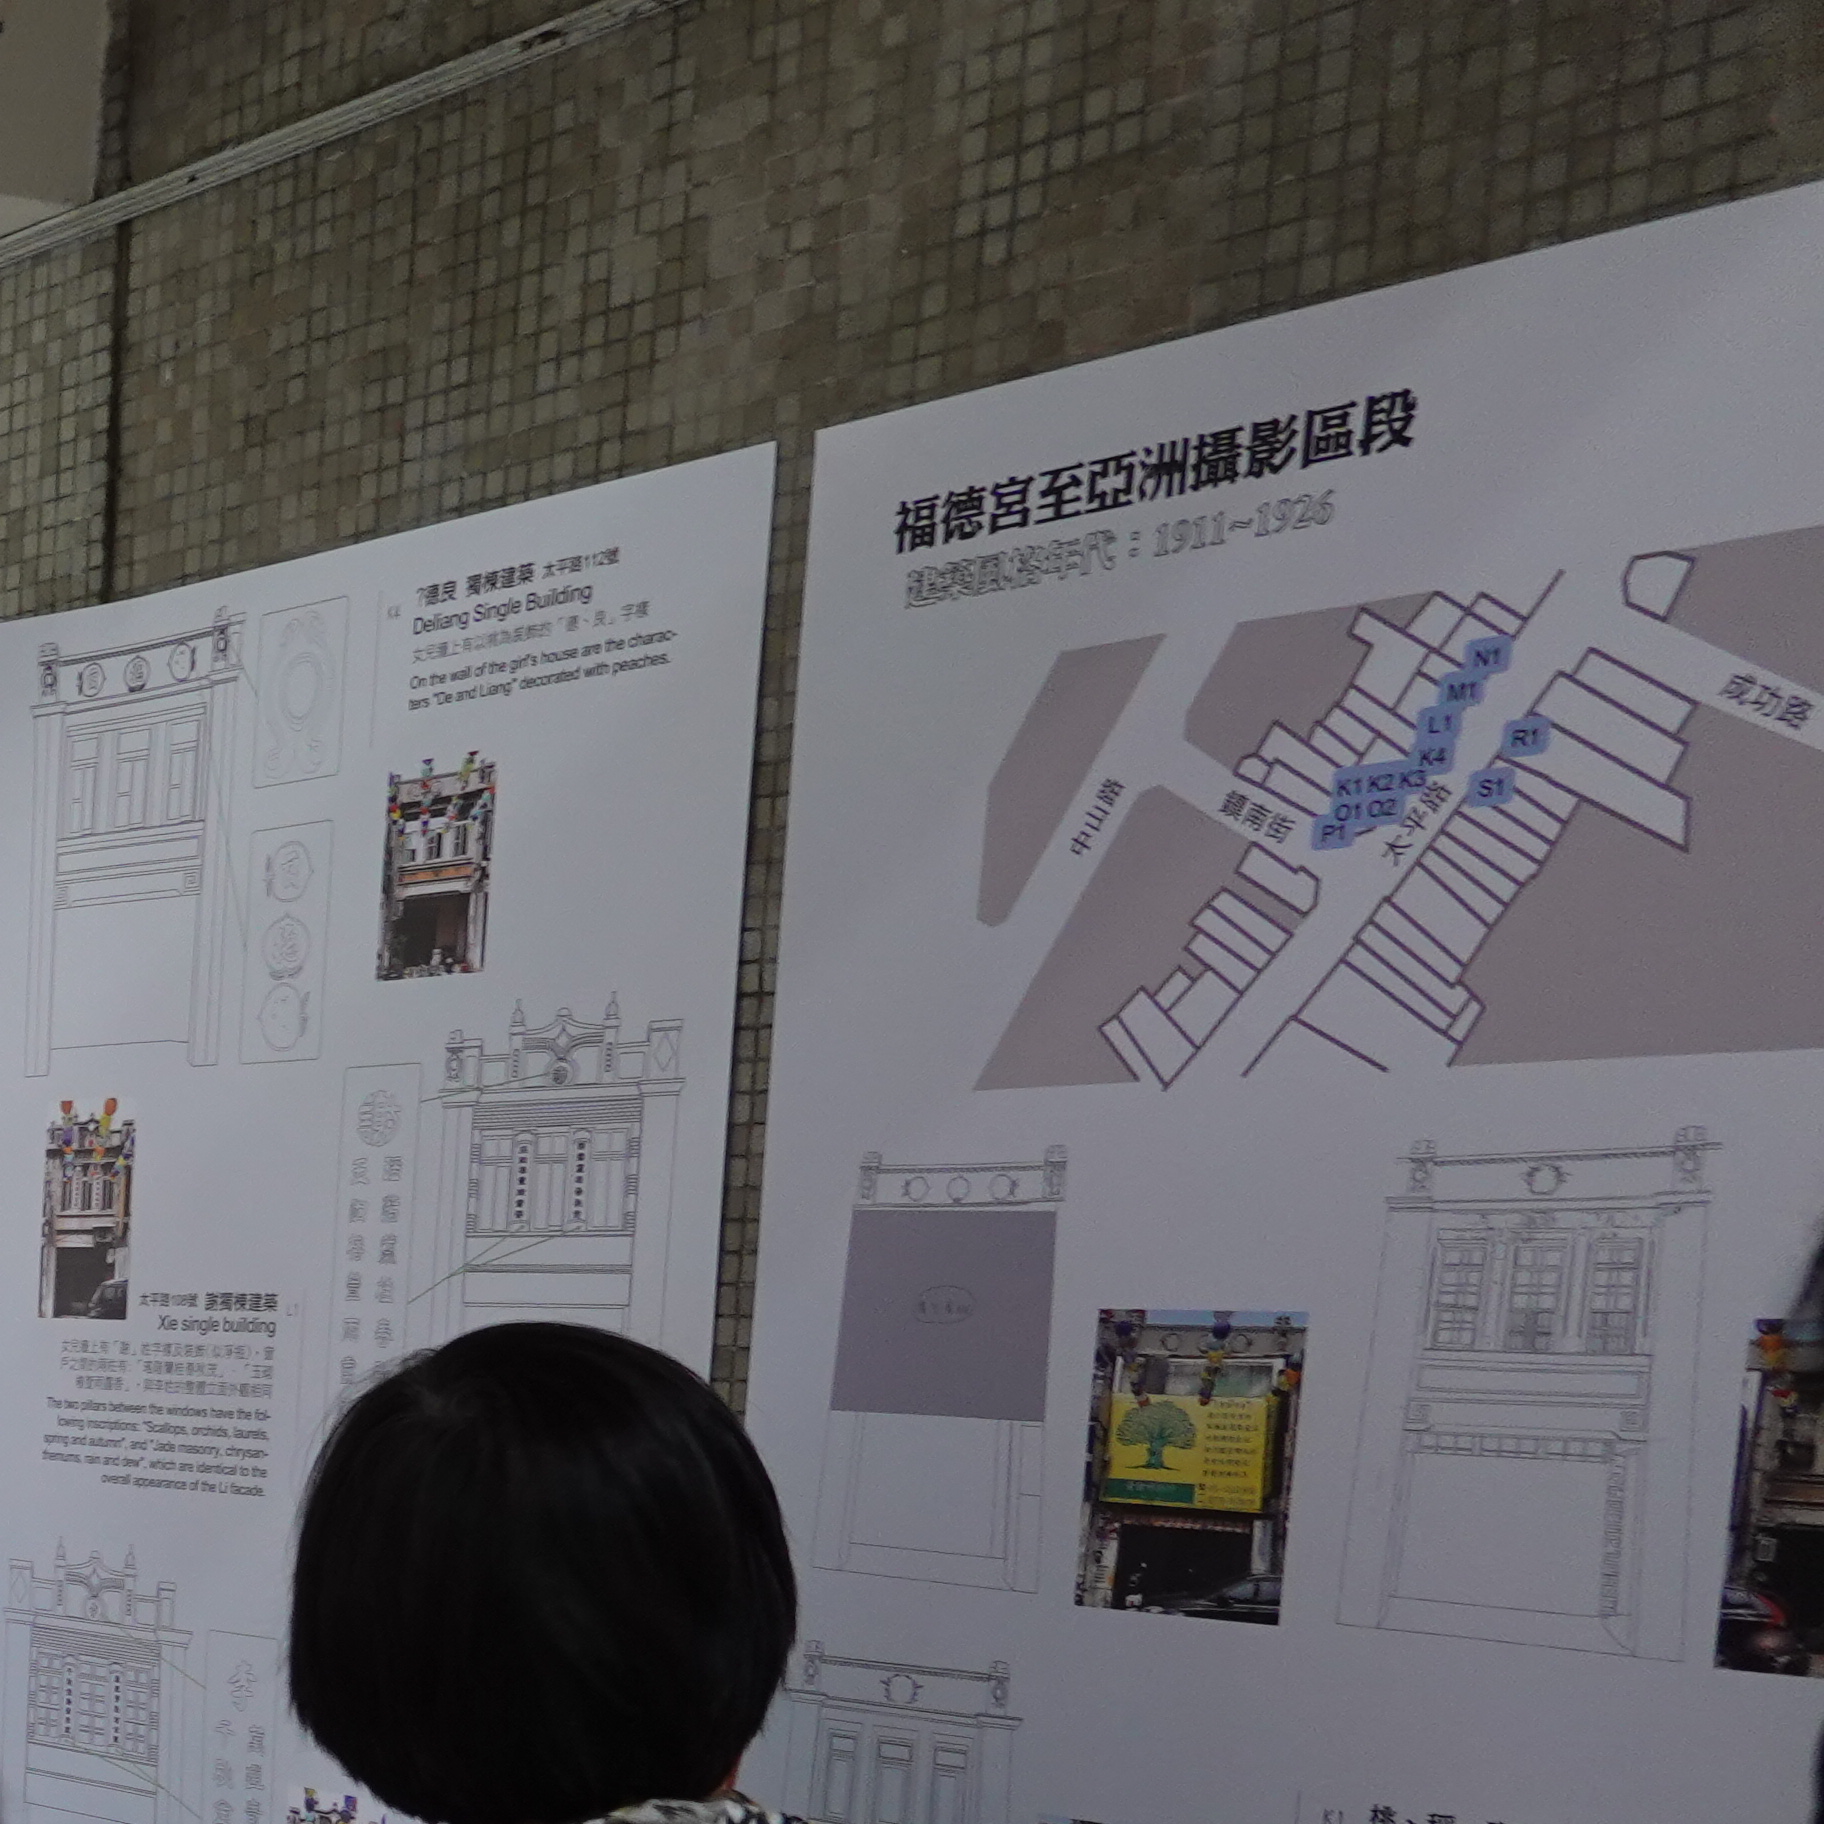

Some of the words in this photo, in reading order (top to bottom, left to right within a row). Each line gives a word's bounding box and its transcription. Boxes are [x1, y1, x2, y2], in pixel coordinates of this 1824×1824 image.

[893, 387, 1417, 554] 福德宮至亞洲攝影區段
[413, 609, 469, 635] Deliang
[473, 597, 521, 622] Single
[525, 585, 593, 614] Building
[429, 669, 448, 685] the
[450, 665, 471, 682] wall
[474, 662, 488, 678] of
[489, 658, 507, 674] the
[540, 645, 579, 664] house
[581, 644, 601, 657] are
[604, 636, 625, 652] the
[1474, 648, 1500, 666] N1
[455, 685, 477, 702] and
[520, 664, 581, 690] decorated
[583, 660, 610, 678] with
[1718, 671, 1816, 731] 成功路
[1428, 715, 1451, 734] L1
[1511, 729, 1538, 747] R1
[1420, 748, 1447, 766] K4
[1337, 779, 1361, 797] K1
[1367, 774, 1393, 793] K2
[1400, 770, 1426, 788] K3
[1478, 779, 1503, 797] S1
[1069, 778, 1126, 856] 中山路
[1381, 780, 1452, 867] 太平路
[157, 1314, 179, 1331] Xie
[181, 1315, 220, 1336] single
[222, 1316, 276, 1337] building
